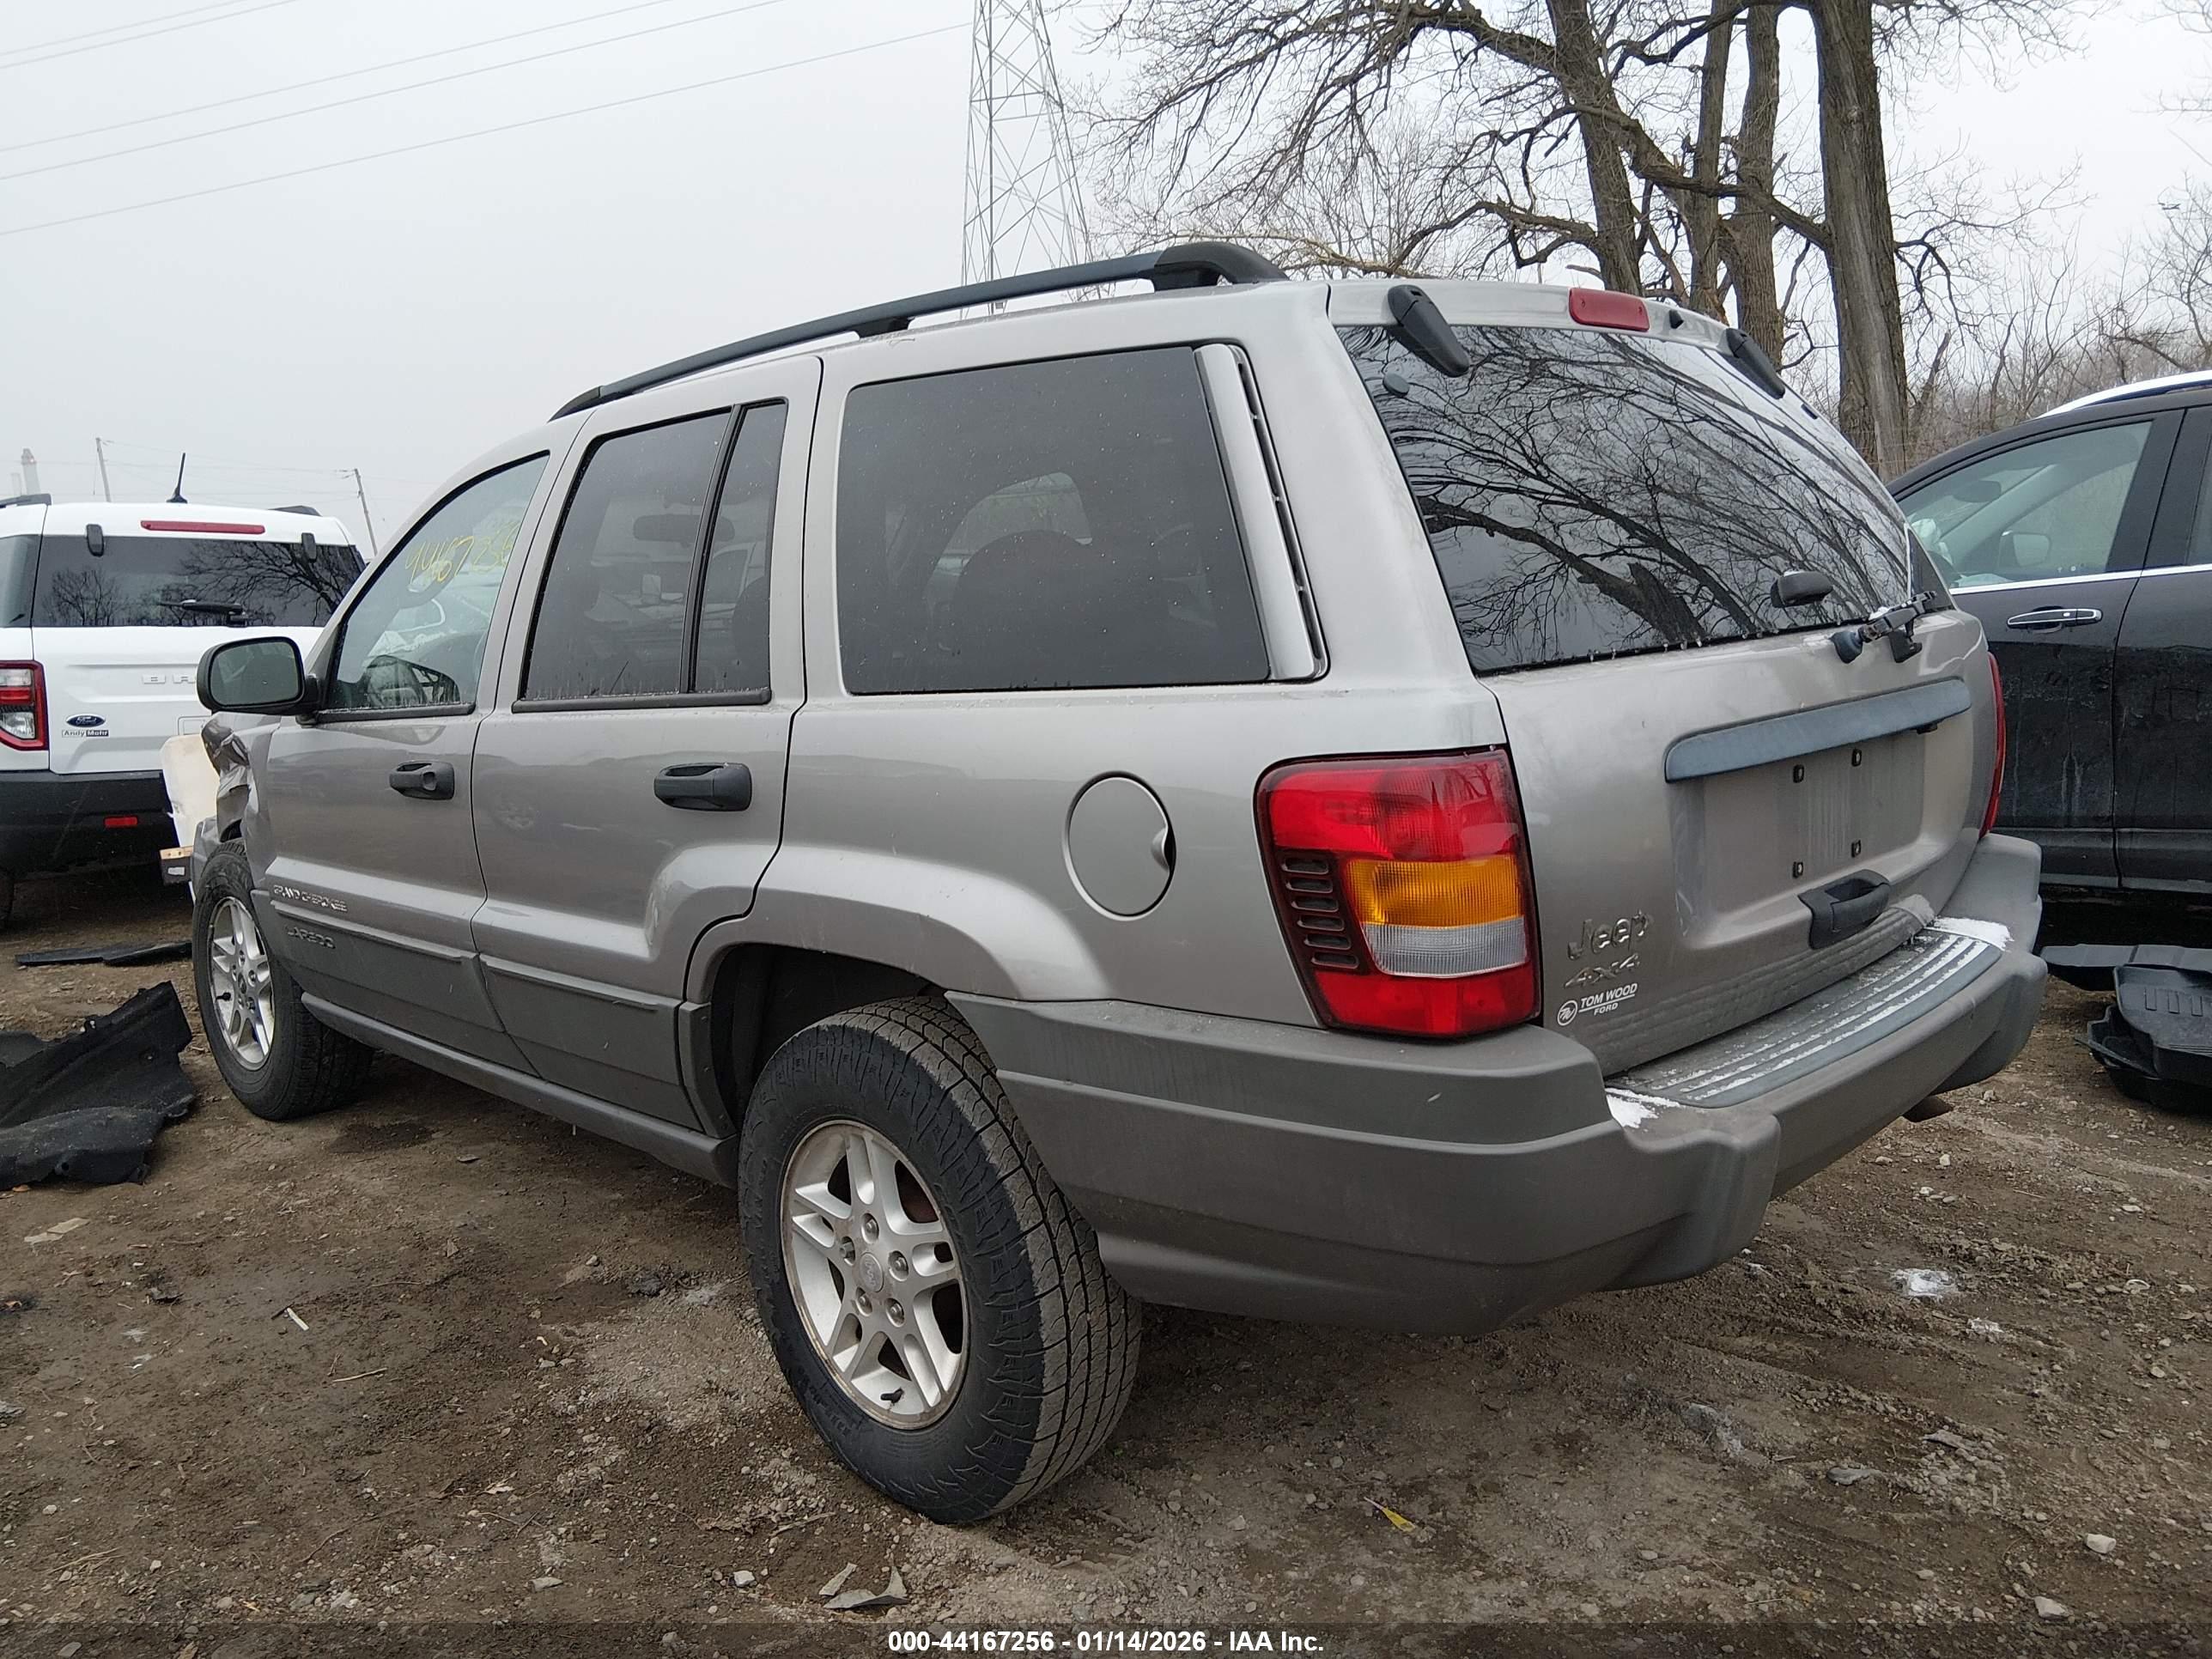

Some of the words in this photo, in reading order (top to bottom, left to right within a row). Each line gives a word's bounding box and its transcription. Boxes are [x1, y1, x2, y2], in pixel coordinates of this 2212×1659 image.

[1567, 908, 1651, 960] Jeep
[1580, 992, 1603, 1008] TOM
[1606, 982, 1638, 1002] WOOD
[1594, 1002, 1619, 1016] FORD
